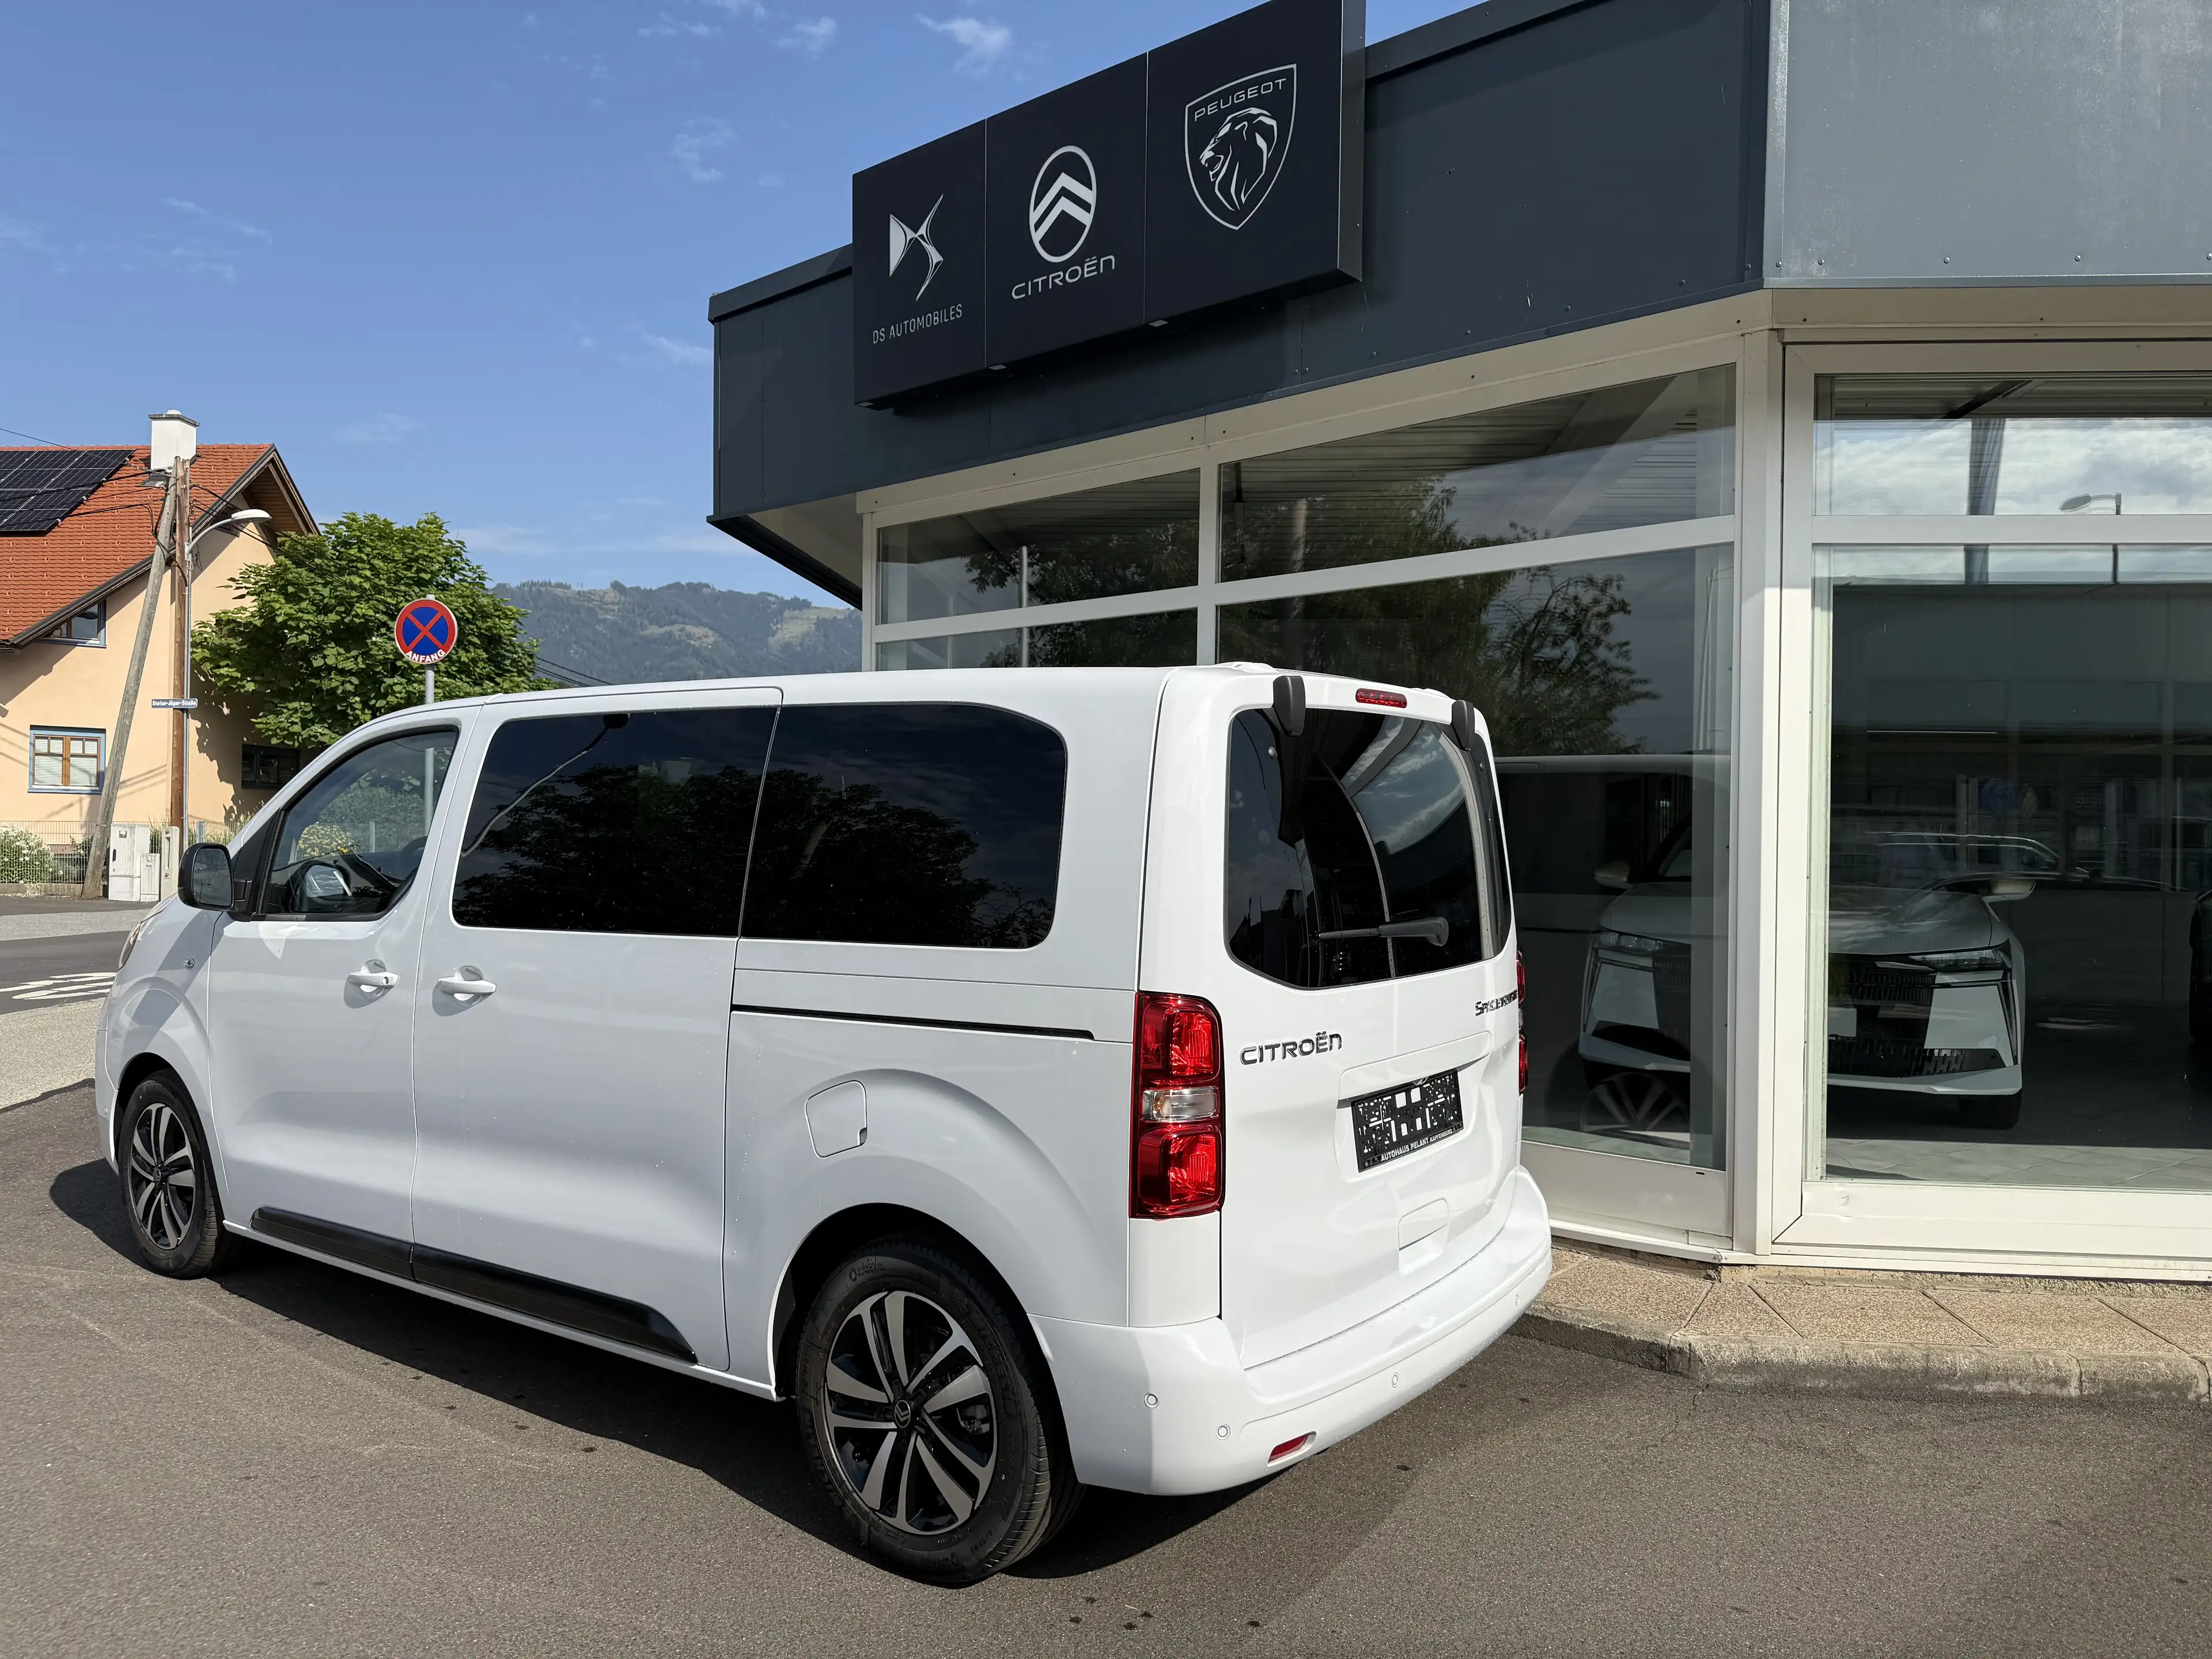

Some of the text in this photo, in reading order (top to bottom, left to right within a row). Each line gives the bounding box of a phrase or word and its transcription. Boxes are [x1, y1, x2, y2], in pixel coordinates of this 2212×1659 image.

[1194, 78, 1286, 122] PEUGEOT
[1012, 255, 1115, 300] CITROËN
[873, 304, 963, 344] DS AUTOMOBILES
[406, 649, 446, 663] ANFANG
[1240, 1031, 1342, 1065] CITROËN
[1381, 1145, 1410, 1162] AUTOHAUS
[1410, 1137, 1430, 1150] PELANT
